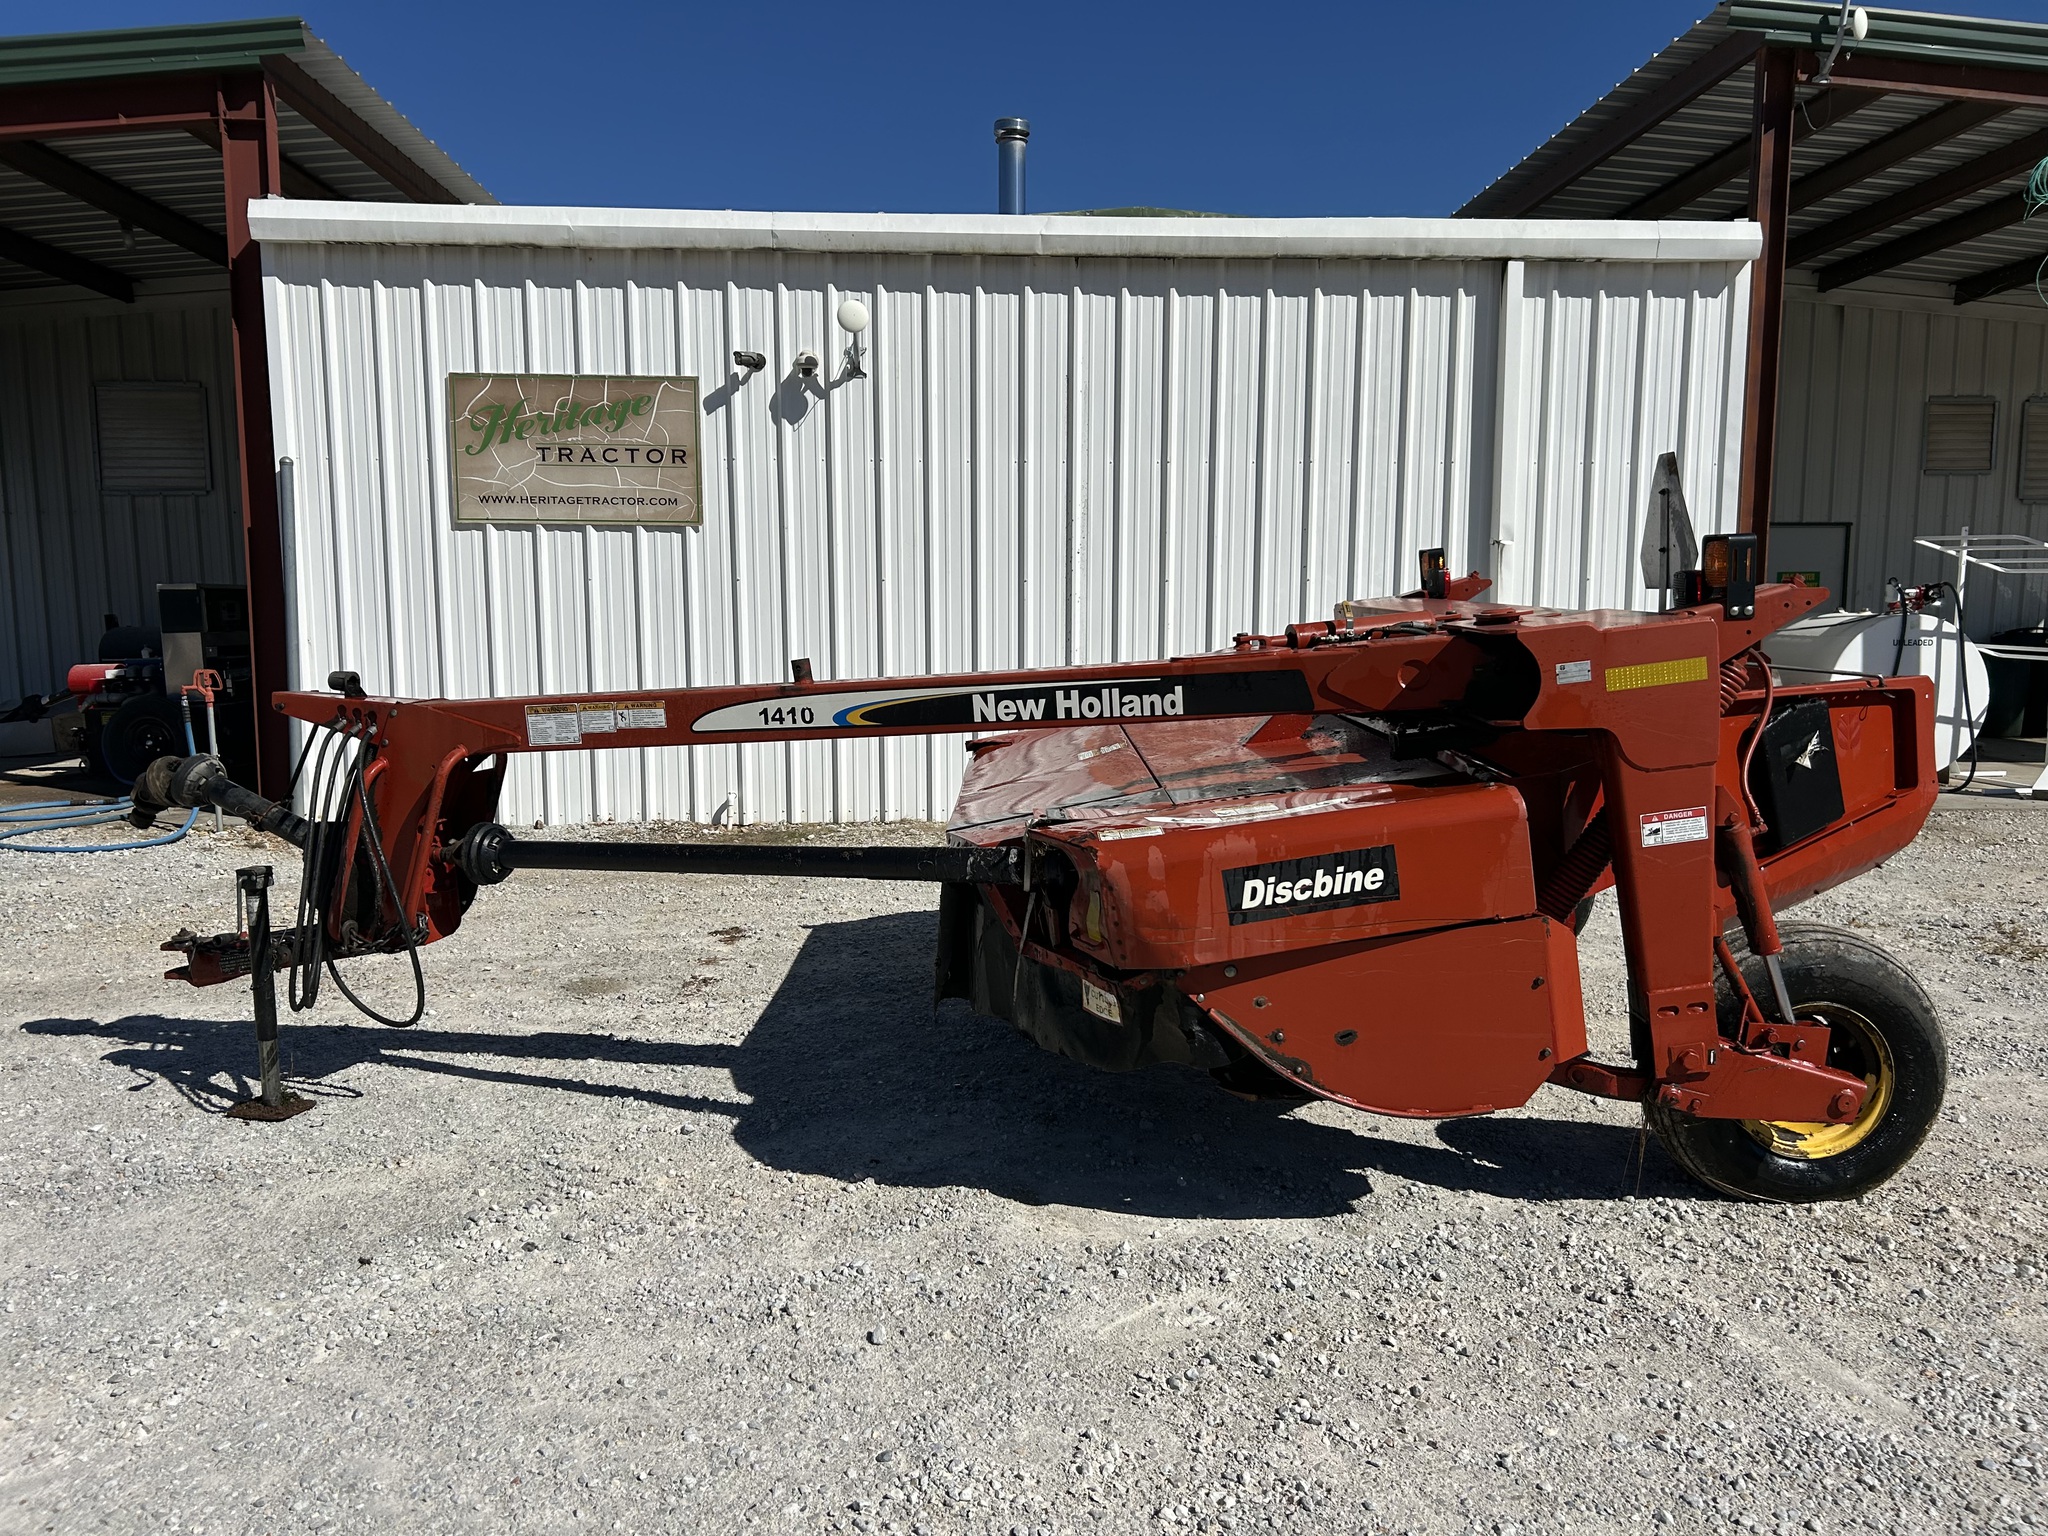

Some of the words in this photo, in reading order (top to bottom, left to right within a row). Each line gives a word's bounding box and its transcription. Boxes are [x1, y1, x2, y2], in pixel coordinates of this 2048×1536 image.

[464, 395, 653, 456] Heritage
[535, 446, 688, 465] TRACTOR
[478, 494, 678, 506] WWW.HERITAGETRACTOR.COM
[1892, 638, 1934, 647] ULEADED
[630, 701, 657, 709] WARNING
[972, 692, 1046, 723] New
[1055, 685, 1184, 720] Holland
[759, 705, 815, 726] 1410
[1663, 810, 1693, 820] DANGER
[1241, 865, 1385, 910] Discbine
